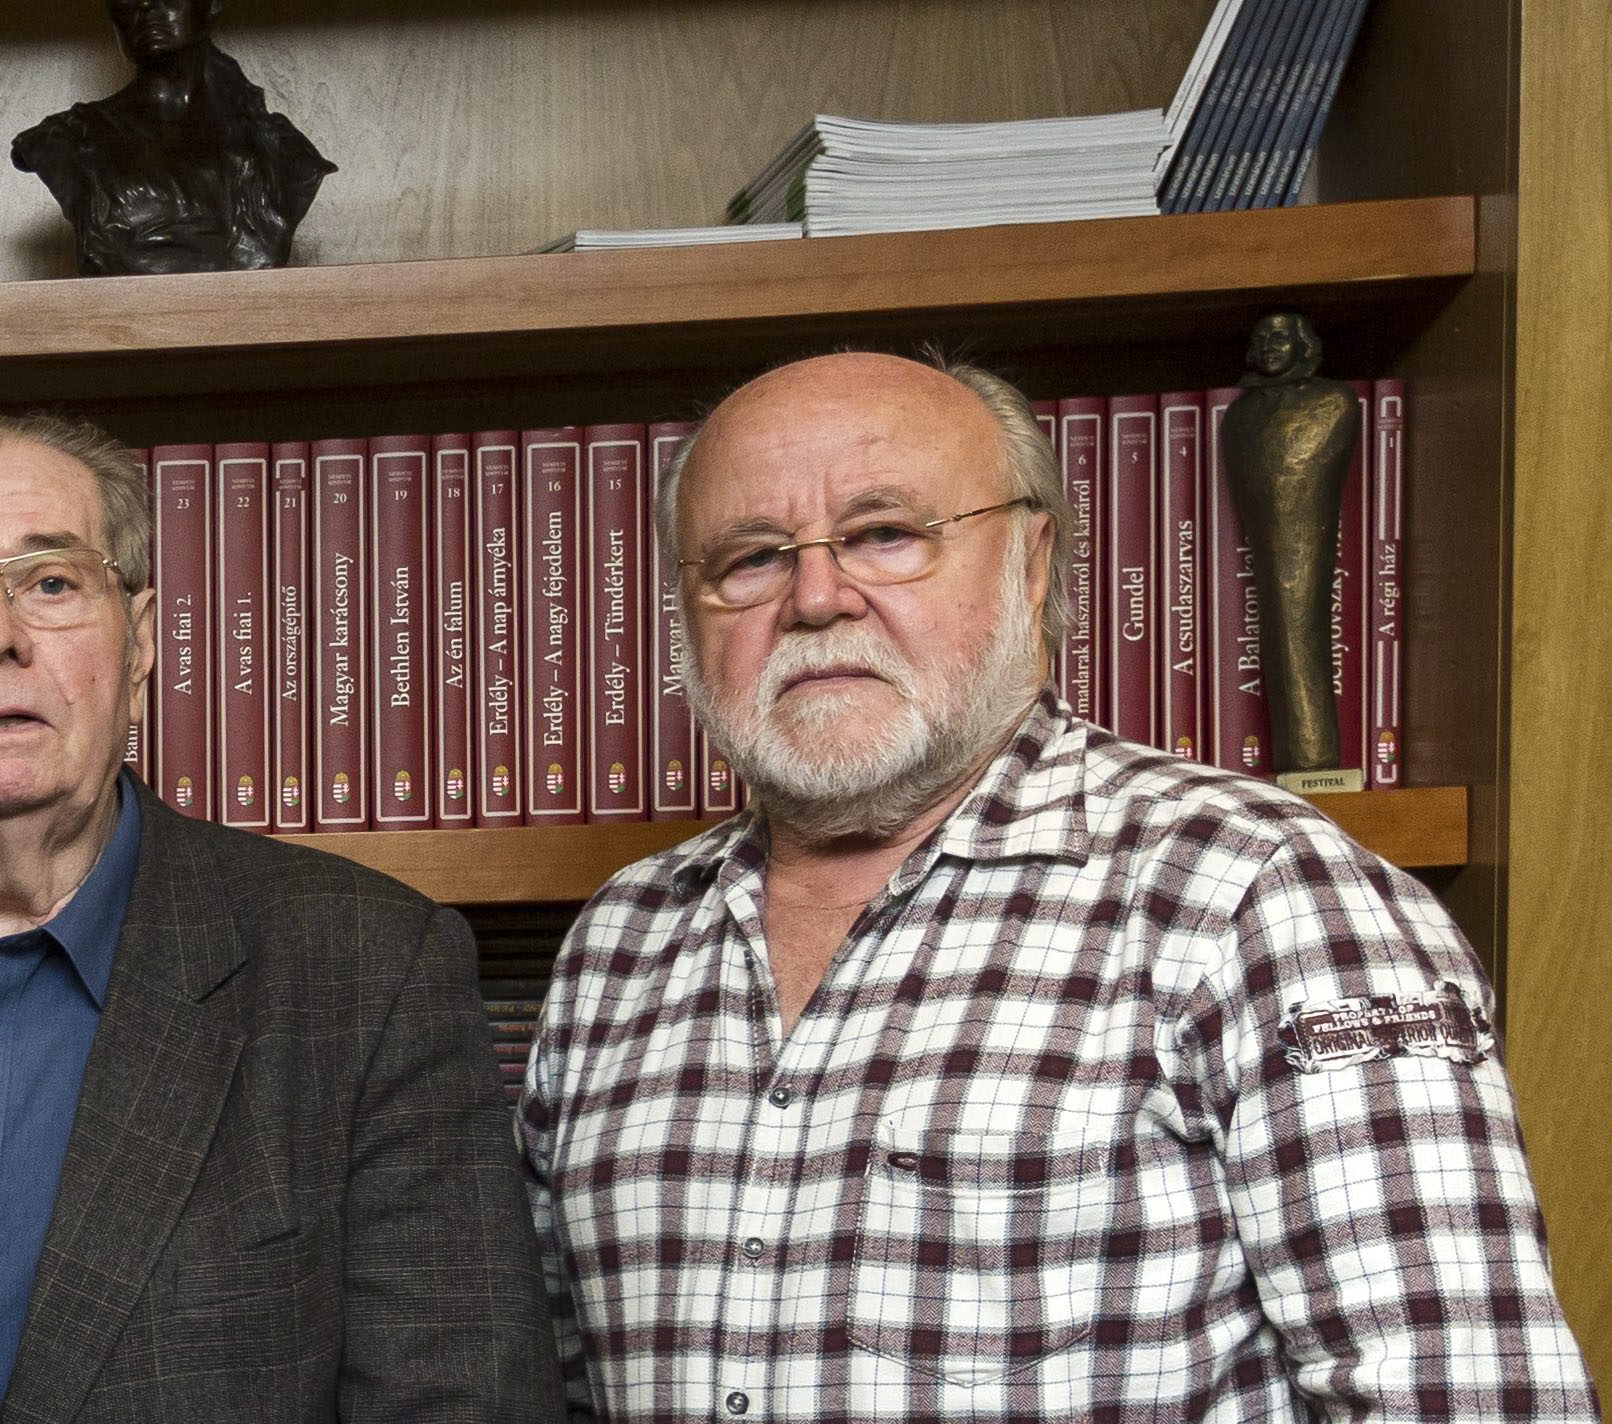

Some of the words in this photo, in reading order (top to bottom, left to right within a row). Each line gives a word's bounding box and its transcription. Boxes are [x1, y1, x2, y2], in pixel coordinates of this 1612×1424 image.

[1078, 454, 1087, 466] 6
[1131, 451, 1139, 465] 5
[1179, 445, 1188, 457] 4
[394, 490, 408, 501] 19
[447, 487, 461, 498] 18
[491, 483, 504, 495] 17
[548, 480, 561, 492] 16
[609, 479, 622, 490] 15
[177, 498, 190, 510] 23
[236, 496, 250, 508] 22
[284, 497, 297, 508] 21
[333, 493, 348, 504] 20
[1071, 480, 1090, 537] káráról
[542, 511, 567, 597] fejedelem
[1073, 541, 1090, 558] és
[1377, 543, 1396, 575] ház
[486, 527, 512, 597] árnyéka
[390, 566, 410, 625] István
[604, 529, 624, 641] Tündérkert
[1172, 520, 1193, 652] csudaszarvas
[176, 594, 191, 606] 2.
[237, 592, 252, 604] 1.
[328, 552, 354, 647] karácsony
[444, 581, 463, 632] falum
[1071, 563, 1090, 640] hasznáról
[1121, 567, 1145, 641] Gundel
[1378, 581, 1400, 616] régi
[172, 612, 192, 641] fiai
[232, 612, 252, 640] fiai
[493, 602, 512, 635] nap
[549, 602, 569, 646] nagy
[1236, 587, 1260, 672] Balaton
[1377, 622, 1395, 636] A
[281, 585, 303, 678] országépítő
[445, 638, 463, 660] én
[488, 639, 507, 654] A
[543, 650, 562, 665] A
[178, 646, 192, 676] vas
[238, 646, 252, 676] vas
[389, 631, 410, 707] Bethlen
[1172, 658, 1193, 676] A
[173, 679, 192, 695] A
[233, 679, 252, 694] A
[445, 664, 463, 688] Az
[1071, 645, 1090, 714] madarak
[1237, 679, 1260, 696] A
[281, 679, 297, 701] Az
[330, 652, 355, 726] Magyar
[605, 662, 630, 726] Erdély
[488, 675, 513, 735] Erdély
[543, 685, 569, 746] Erdély
[1301, 776, 1346, 789] FESTIVAL
[1312, 1017, 1370, 1033] FELLOWS
[1384, 1009, 1436, 1025] FRIENDS
[1398, 1004, 1414, 1014] OF
